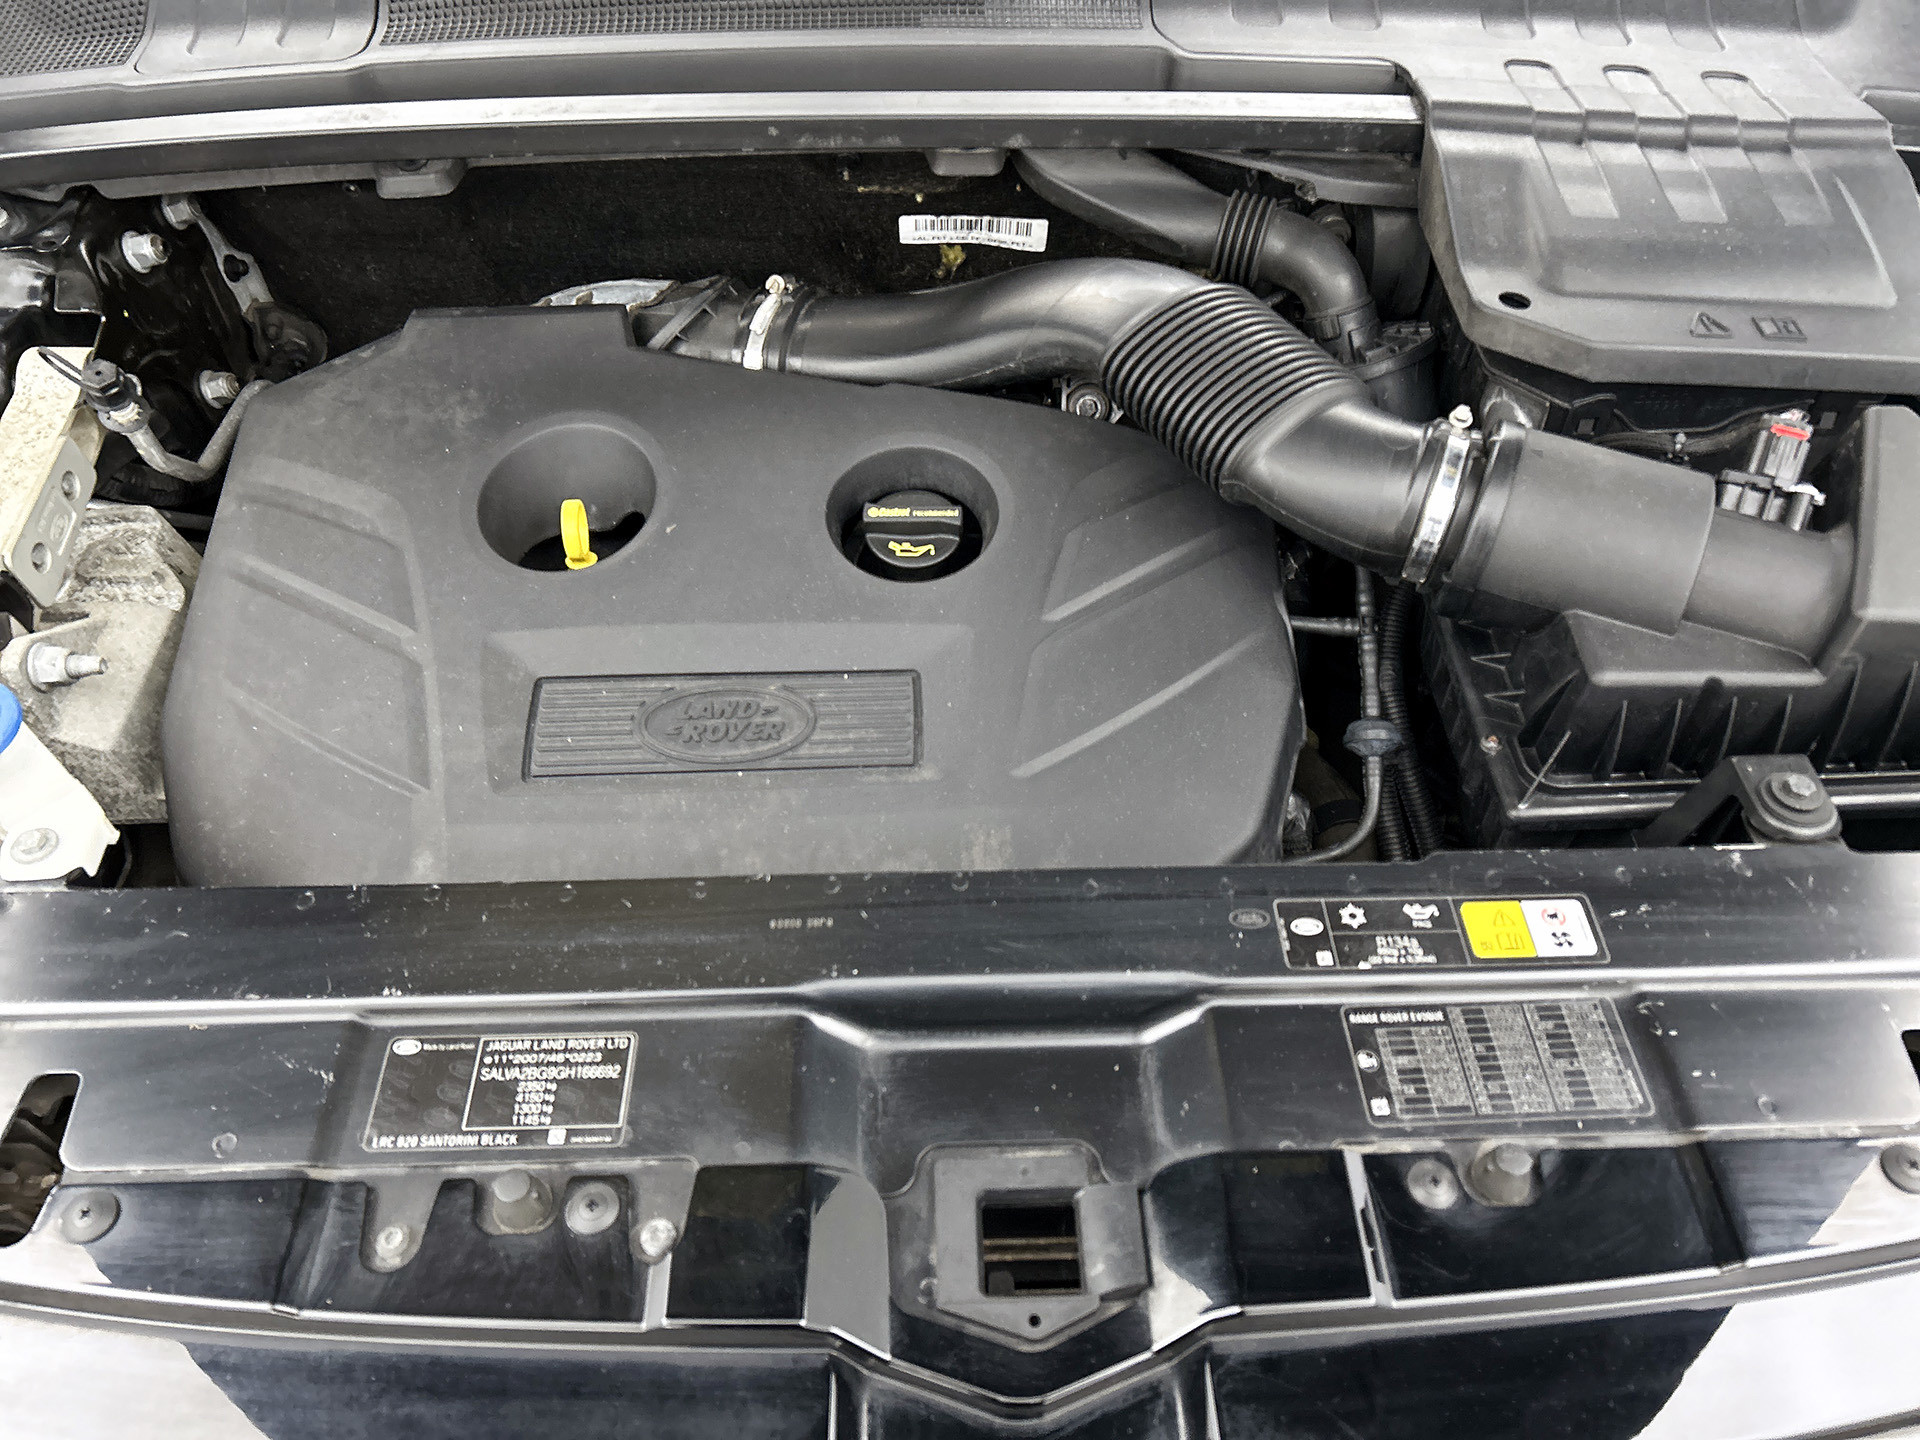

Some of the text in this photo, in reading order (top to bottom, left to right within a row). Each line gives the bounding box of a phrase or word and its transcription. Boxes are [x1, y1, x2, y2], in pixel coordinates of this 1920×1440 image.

[683, 720, 787, 744] ROVER
[486, 1038, 629, 1052] JAGUAR LAND ROVER LTD
[371, 1135, 396, 1149] LRC
[419, 1133, 480, 1148] SANTORINI
[480, 1133, 518, 1147] BLACK
